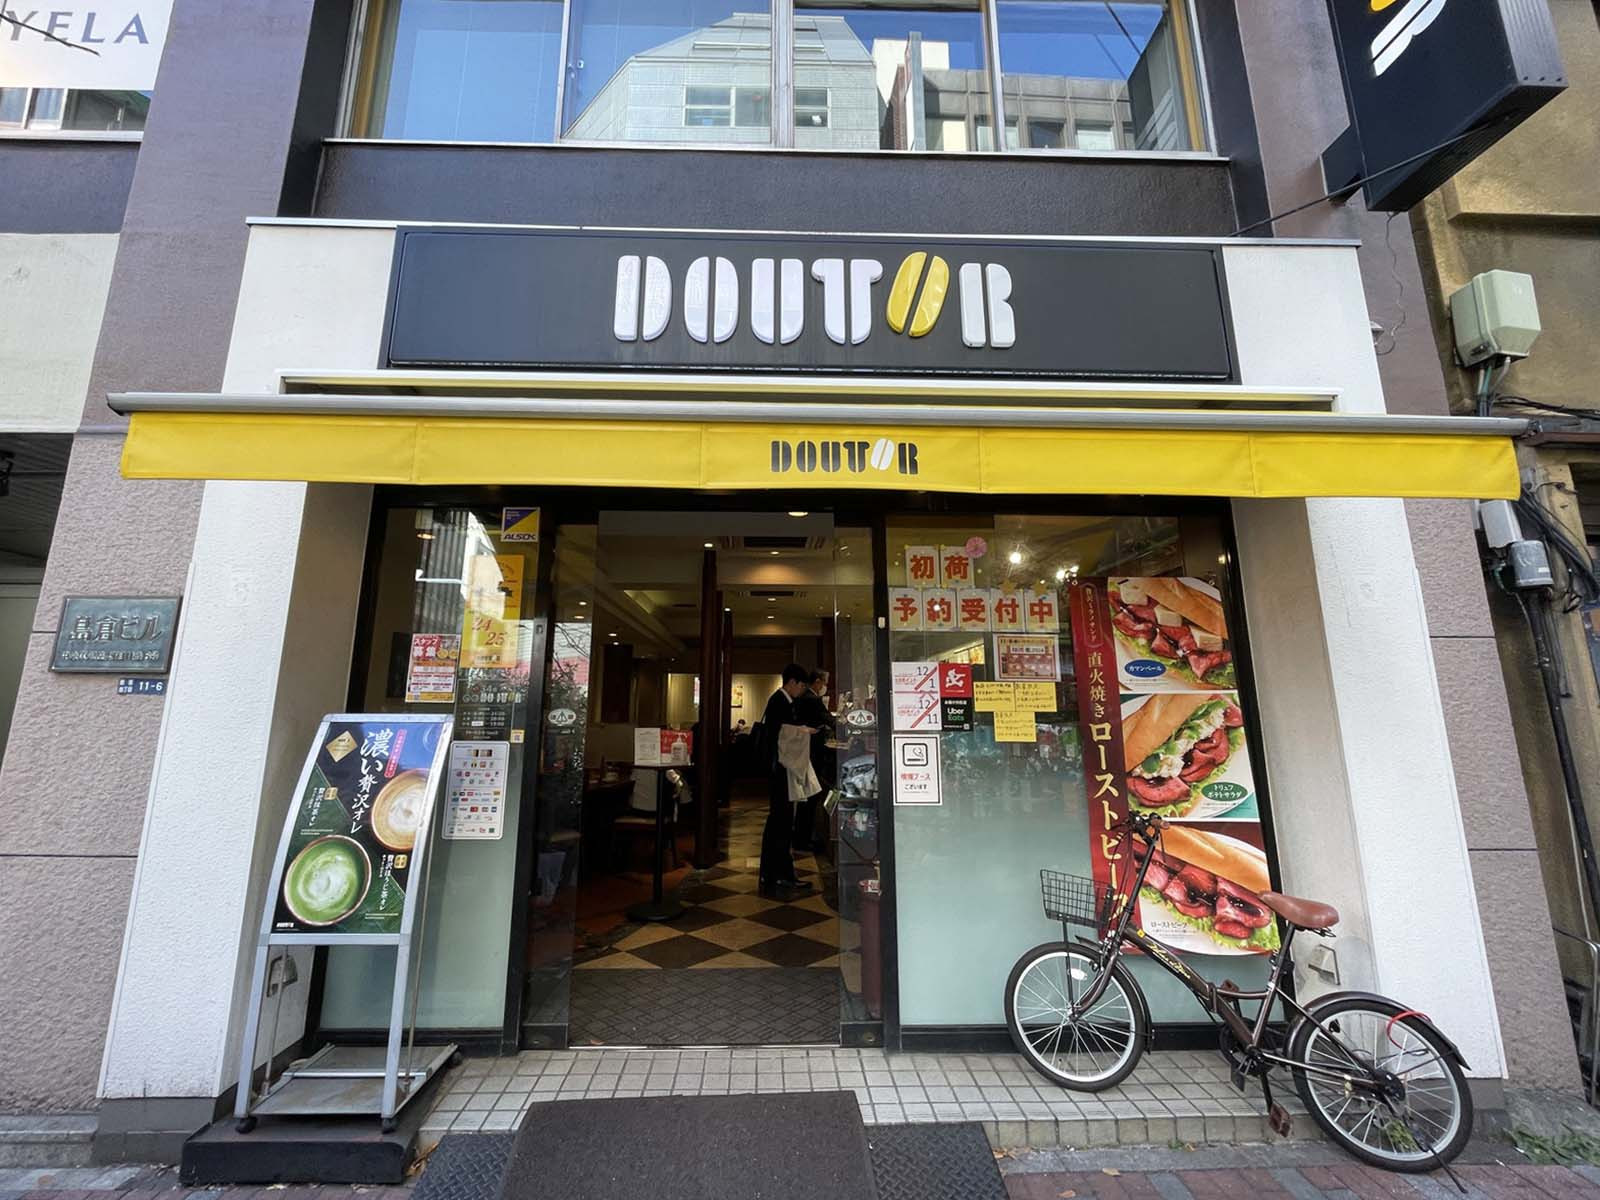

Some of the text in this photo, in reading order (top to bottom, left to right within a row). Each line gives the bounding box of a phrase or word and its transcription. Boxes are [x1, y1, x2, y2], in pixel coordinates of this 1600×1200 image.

[5, 10, 149, 44] YELA
[613, 251, 1017, 348] DOUTOR
[771, 438, 919, 475] DOUTOR
[504, 533, 537, 541] ALSOK
[910, 554, 969, 581] 初荷
[893, 597, 1054, 624] 予約受付中
[484, 631, 507, 646] 25
[1129, 665, 1162, 673] カマンベール
[139, 681, 163, 691] 11-6
[1088, 652, 1106, 718] 直火焼き
[947, 707, 964, 715] Uber
[350, 728, 393, 834] 濃い贅沢オレ
[1207, 791, 1242, 799] ポテトサラダ
[1150, 921, 1188, 929] ローストビーフ
